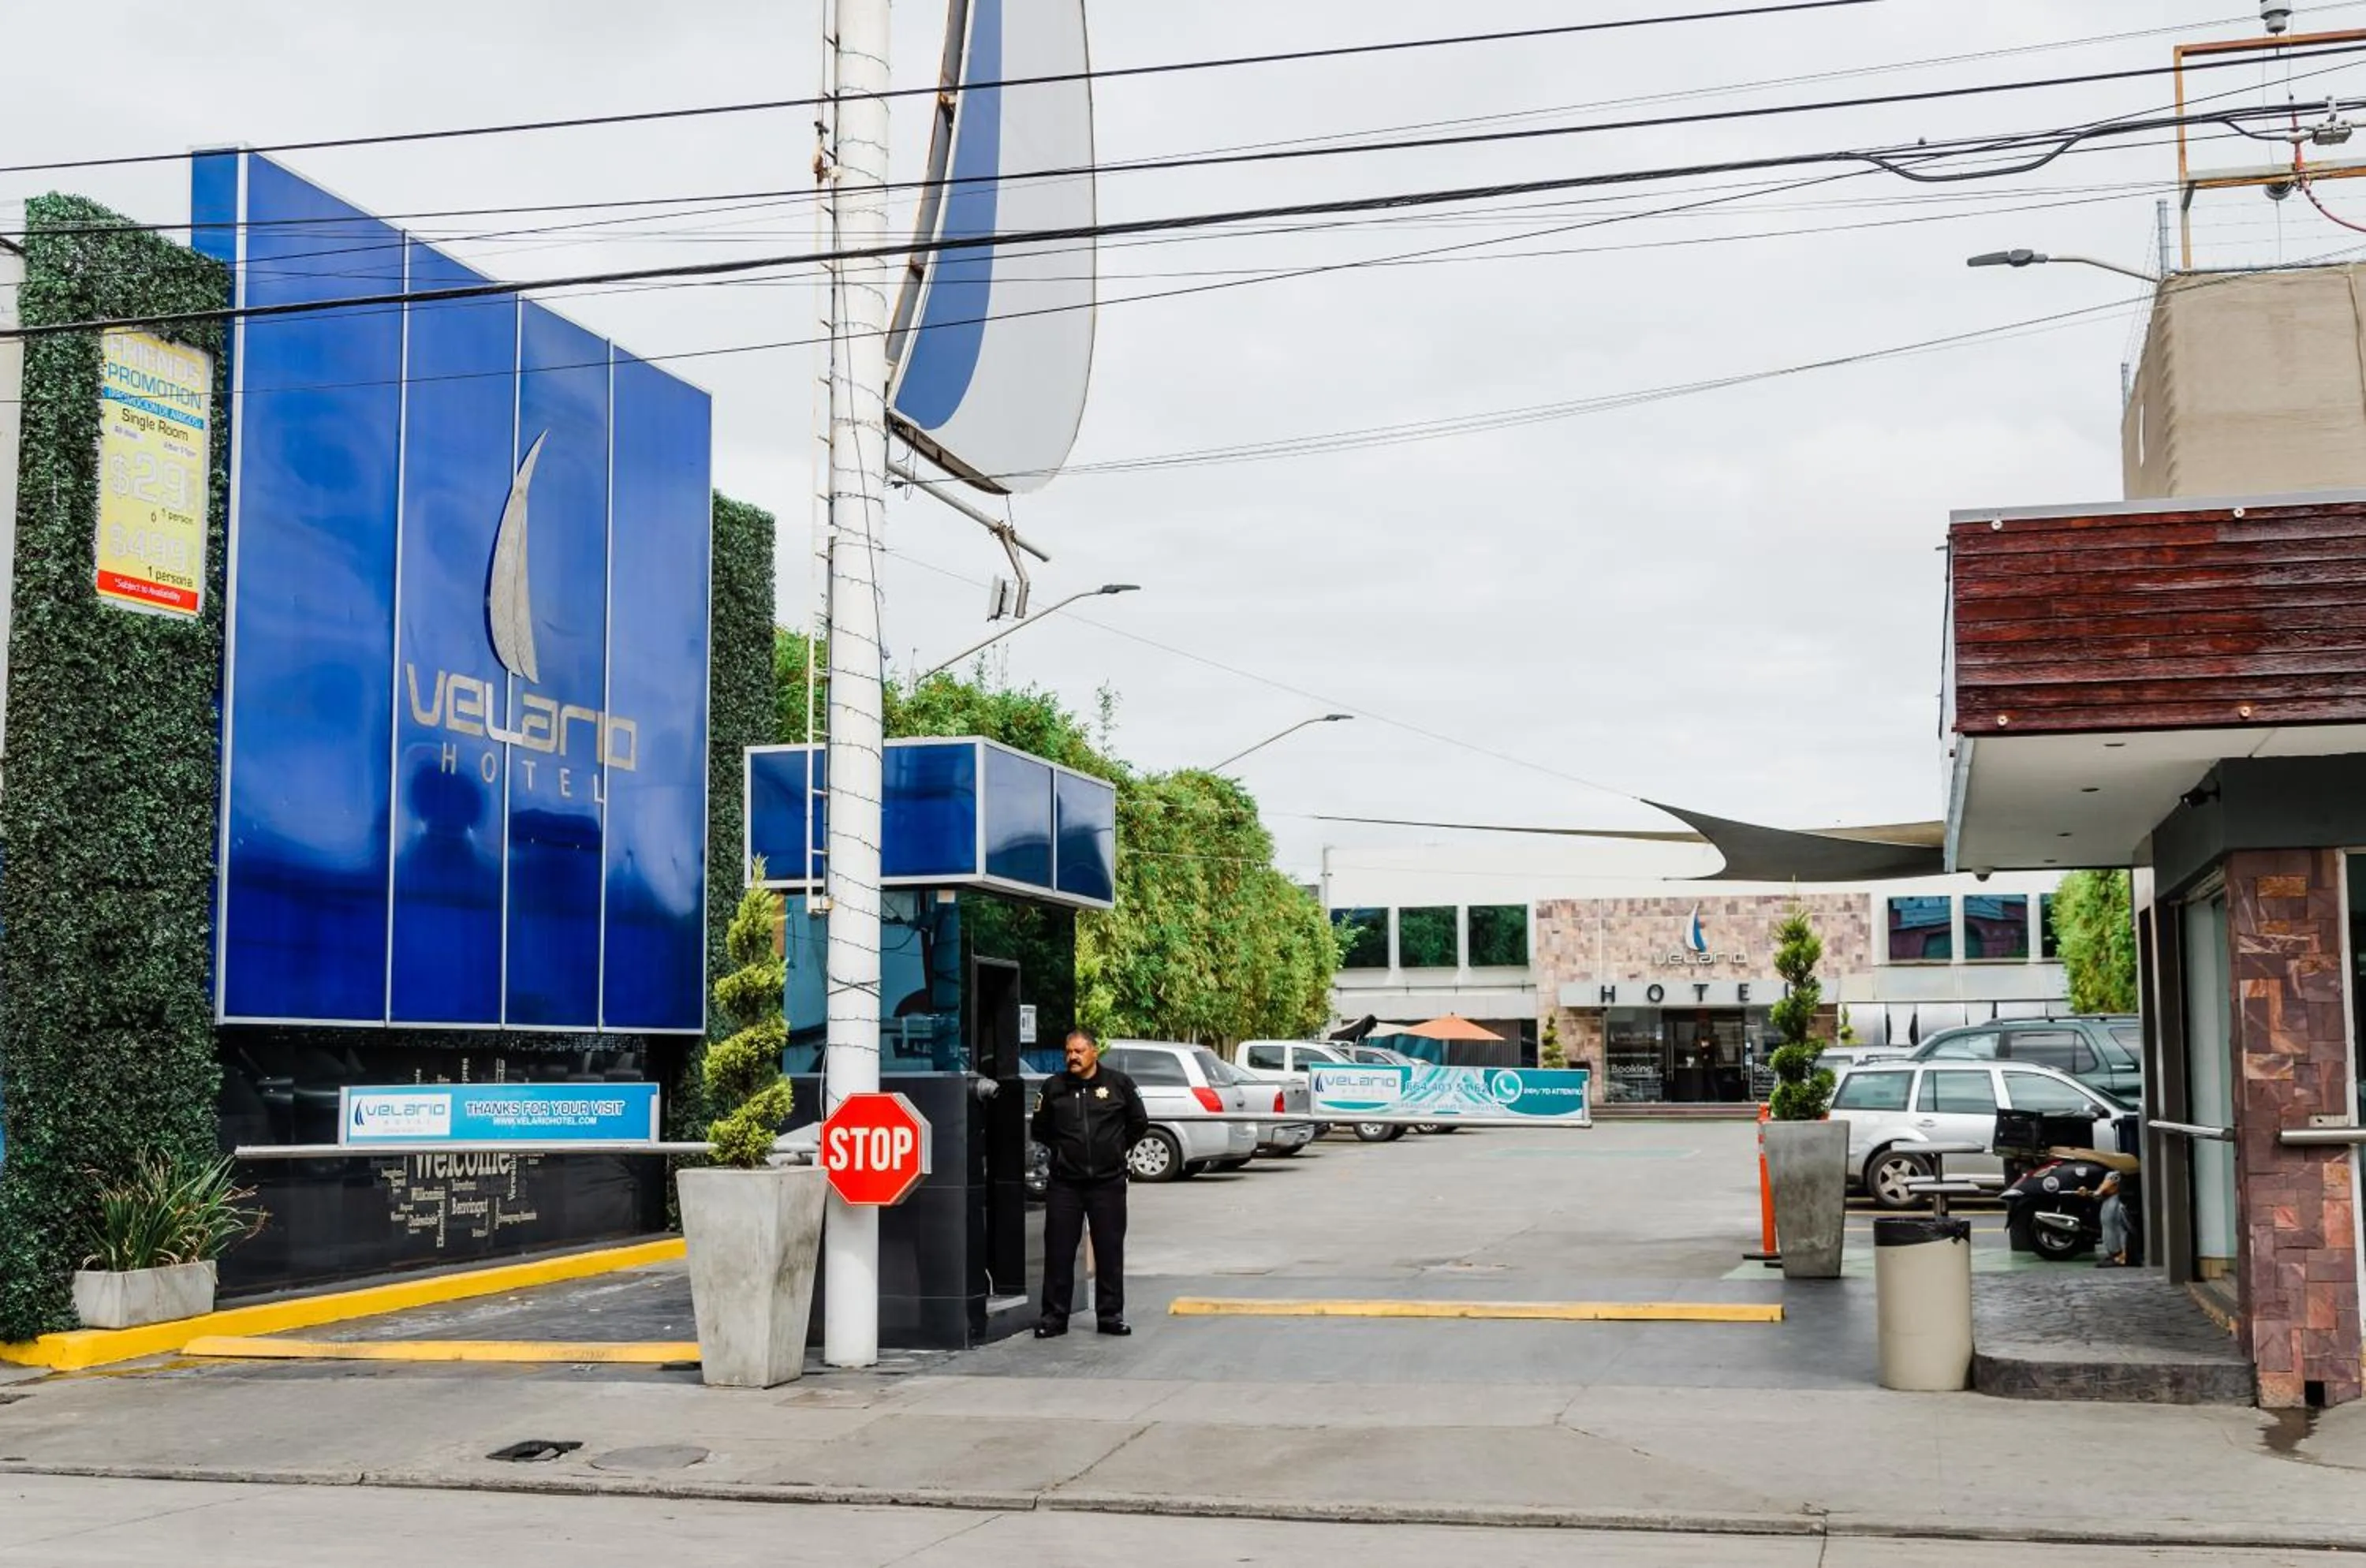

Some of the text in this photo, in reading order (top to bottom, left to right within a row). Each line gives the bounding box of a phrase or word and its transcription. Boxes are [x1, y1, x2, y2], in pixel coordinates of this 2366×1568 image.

[106, 362, 202, 410] PROMOTION
[121, 408, 155, 431] Single
[158, 419, 189, 442] Room
[147, 566, 194, 588] 1 persona
[440, 741, 606, 805] HOTEL
[465, 1100, 625, 1117] THANKS FOR YOUR VISIT
[415, 1152, 513, 1180] Welcome
[828, 1126, 913, 1172] STOP
